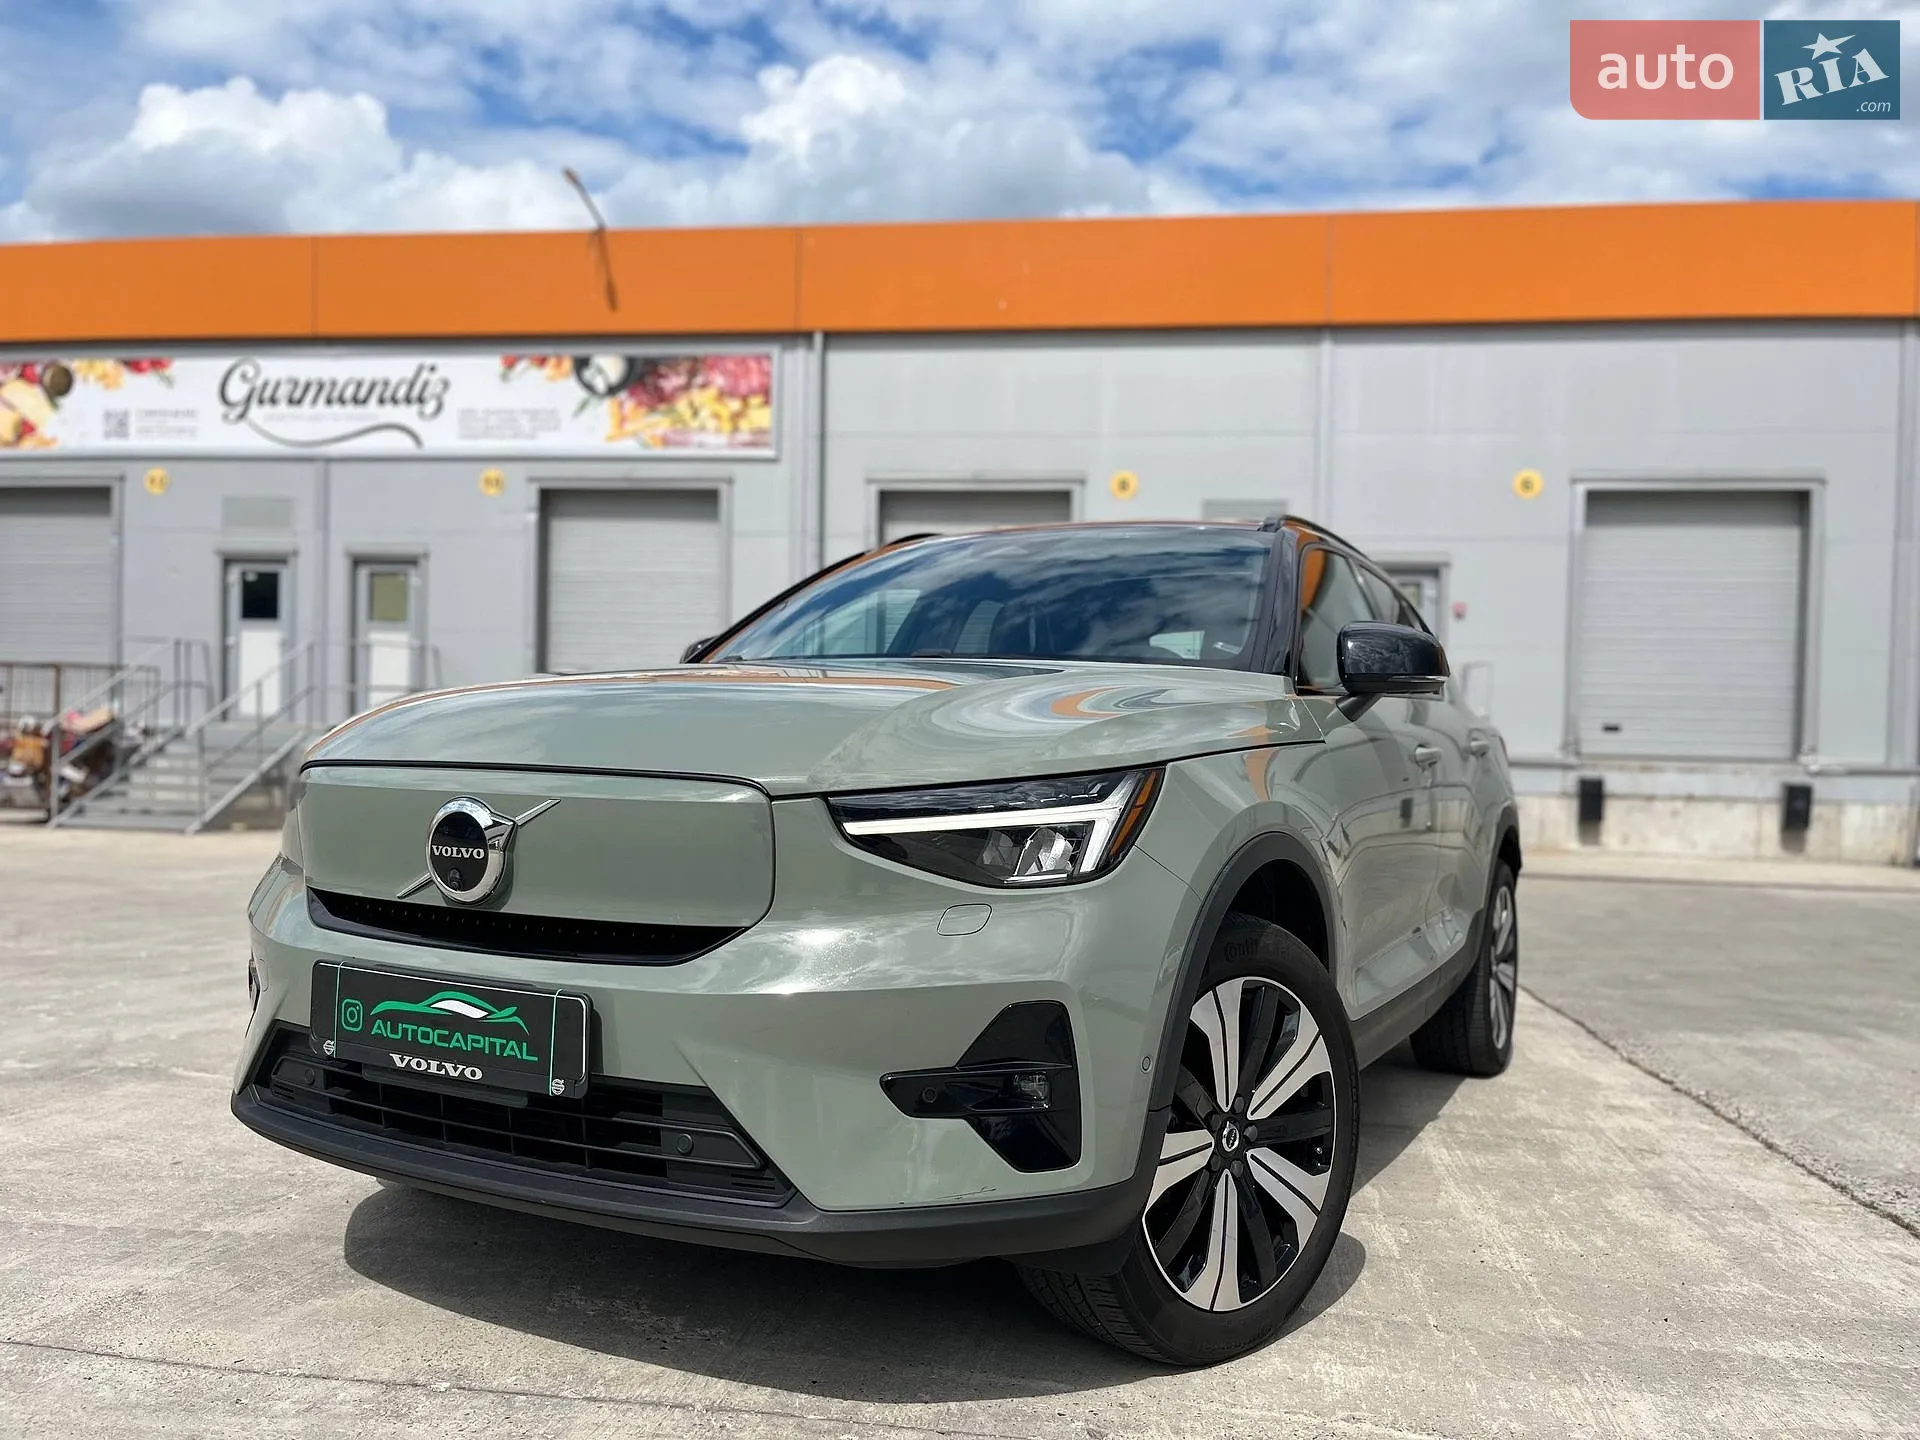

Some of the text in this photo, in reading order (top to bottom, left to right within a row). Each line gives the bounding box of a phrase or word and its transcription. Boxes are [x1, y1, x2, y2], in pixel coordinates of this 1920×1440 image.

[218, 357, 451, 423] Gurmandiz
[432, 845, 484, 859] VOLVO
[371, 1019, 538, 1062] AUTOCAPITAL
[389, 1053, 482, 1080] VOLVO
